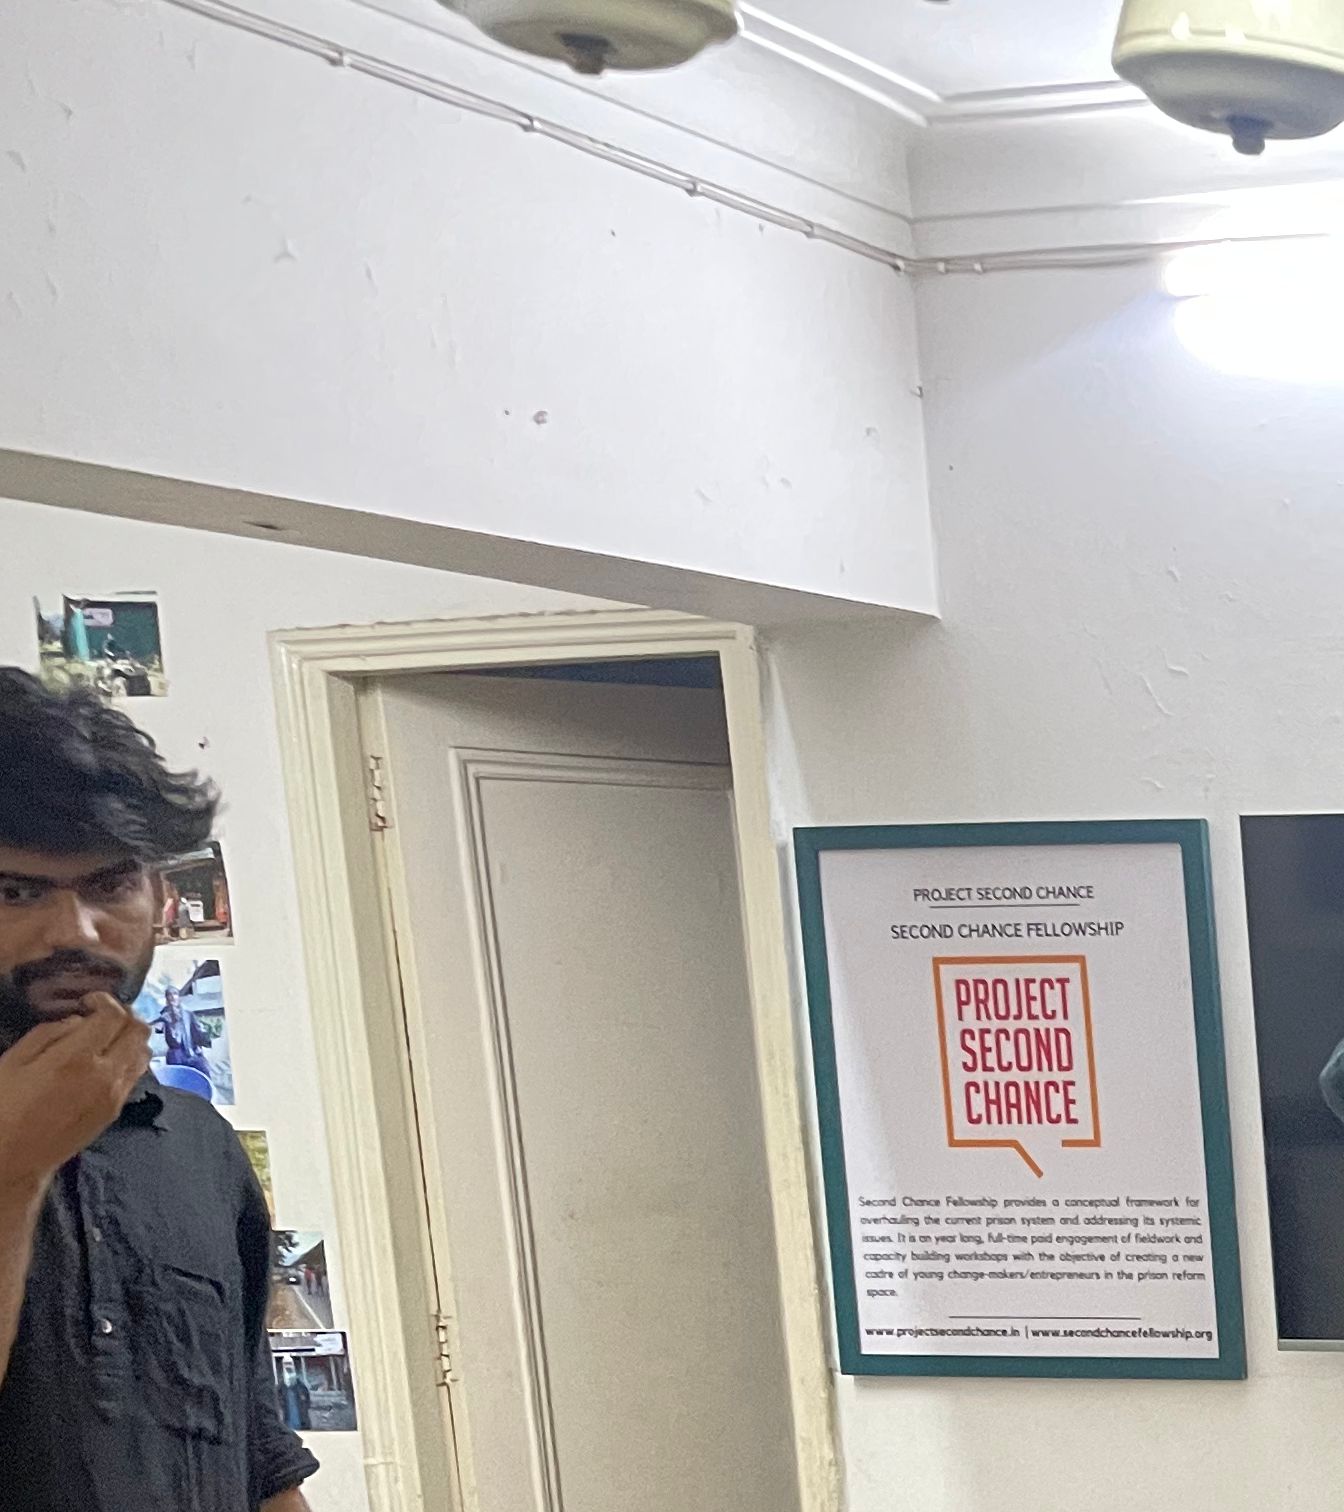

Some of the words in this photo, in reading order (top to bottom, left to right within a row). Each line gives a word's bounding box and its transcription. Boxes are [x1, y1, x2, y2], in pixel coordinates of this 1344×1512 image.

[913, 887, 973, 901] PROJECT
[976, 886, 1033, 900] SECOND
[1036, 885, 1094, 899] CHANCE
[891, 923, 953, 939] SECOND
[958, 922, 1022, 938] CHANCE
[1027, 921, 1124, 937] FELLOWSHIP
[955, 977, 1070, 1021] PROJECT
[960, 1027, 1073, 1072] SECOND
[964, 1080, 1079, 1124] CHANCE
[858, 1196, 896, 1207] Second
[902, 1196, 940, 1207] Chance
[946, 1196, 998, 1209] Fellowship
[1003, 1197, 1046, 1209] provides
[1052, 1199, 1060, 1207] a
[1065, 1196, 1120, 1209] conceptual
[1126, 1196, 1179, 1207] framework
[1185, 1196, 1200, 1207] for
[860, 1215, 920, 1227] overhauling
[924, 1215, 940, 1225] the
[945, 1216, 982, 1225] current
[986, 1216, 1016, 1227] prison
[1021, 1217, 1055, 1227] system
[1060, 1215, 1079, 1225] and
[1084, 1215, 1138, 1228] addressing
[1143, 1216, 1155, 1225] its
[1159, 1216, 1202, 1228] systemic
[919, 1235, 932, 1243] an
[934, 1235, 957, 1245] year
[988, 1232, 1028, 1243] full-time
[1031, 1233, 1052, 1245] paid
[1055, 1234, 1118, 1246] engagement
[1121, 1232, 1131, 1243] of
[1135, 1232, 1181, 1244] fieldwork
[1184, 1233, 1203, 1244] and
[863, 1252, 907, 1262] capacity
[911, 1251, 950, 1263] building
[954, 1251, 1008, 1263] workshops
[1012, 1252, 1034, 1261] with
[1038, 1252, 1055, 1261] the
[1059, 1252, 1106, 1264] objective
[1110, 1251, 1121, 1262] of
[1125, 1252, 1168, 1264] creating
[1171, 1254, 1179, 1262] a
[1183, 1254, 1204, 1262] new
[865, 1269, 894, 1279] cadre
[898, 1268, 909, 1279] of
[912, 1271, 944, 1281] young
[1104, 1270, 1113, 1279] in
[1117, 1270, 1133, 1280] the
[1138, 1271, 1168, 1282] prison
[1172, 1270, 1206, 1280] reform
[865, 1325, 1020, 1338] www.projectsecondchance.in
[1031, 1327, 1213, 1341] www.secondchancefellowship.org
